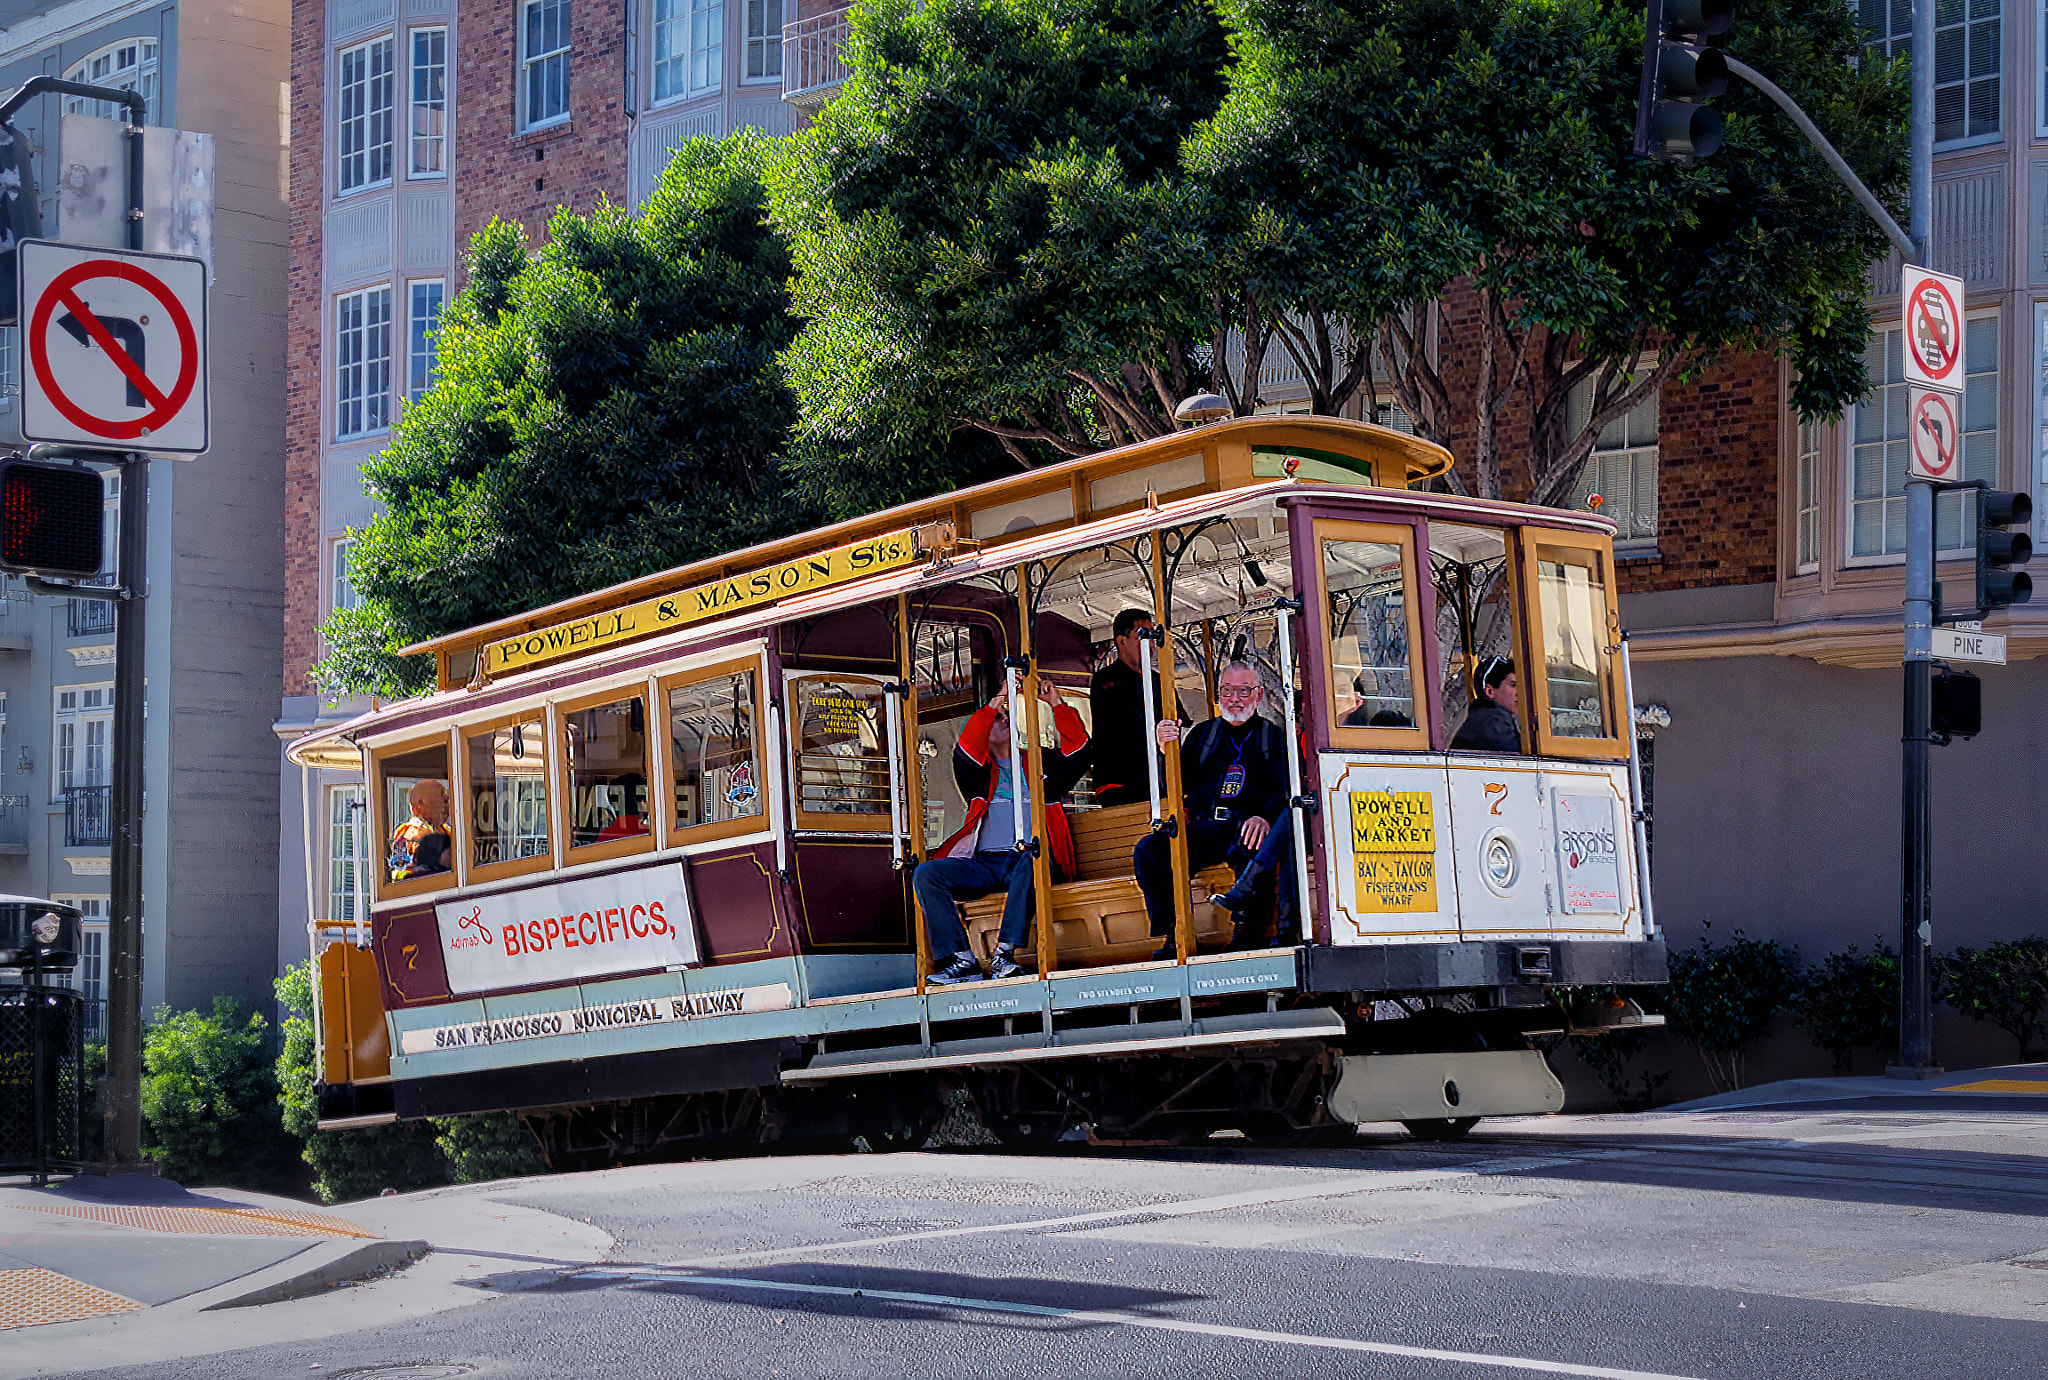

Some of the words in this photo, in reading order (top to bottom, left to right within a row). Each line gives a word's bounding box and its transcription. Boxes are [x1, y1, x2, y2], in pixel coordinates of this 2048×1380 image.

[498, 612, 636, 664] POWELL
[657, 600, 681, 621] &
[696, 556, 833, 612] MASON
[850, 541, 908, 571] Sts.
[1953, 636, 1983, 656] PINE
[1482, 781, 1509, 816] 7
[1356, 800, 1429, 815] POWELL
[1377, 816, 1412, 827] AND
[1356, 828, 1431, 842] MARKET
[1357, 861, 1377, 878] BAY
[1393, 861, 1432, 878] TAYLOR
[1365, 881, 1428, 894] FISHERMANS
[1380, 894, 1414, 906] WHARF
[501, 900, 677, 957] BISPECIFICS,
[401, 943, 419, 970] 7
[1196, 980, 1215, 989] TWO
[1257, 973, 1279, 983] ONLY
[1078, 990, 1095, 999] TWO
[1134, 985, 1155, 994] ONLY
[948, 1005, 965, 1014] TWO
[1000, 998, 1020, 1007] ONLY
[435, 1027, 468, 1048] SAN
[471, 1015, 563, 1045] FRANCISCO
[671, 992, 745, 1019] RAILWAY
